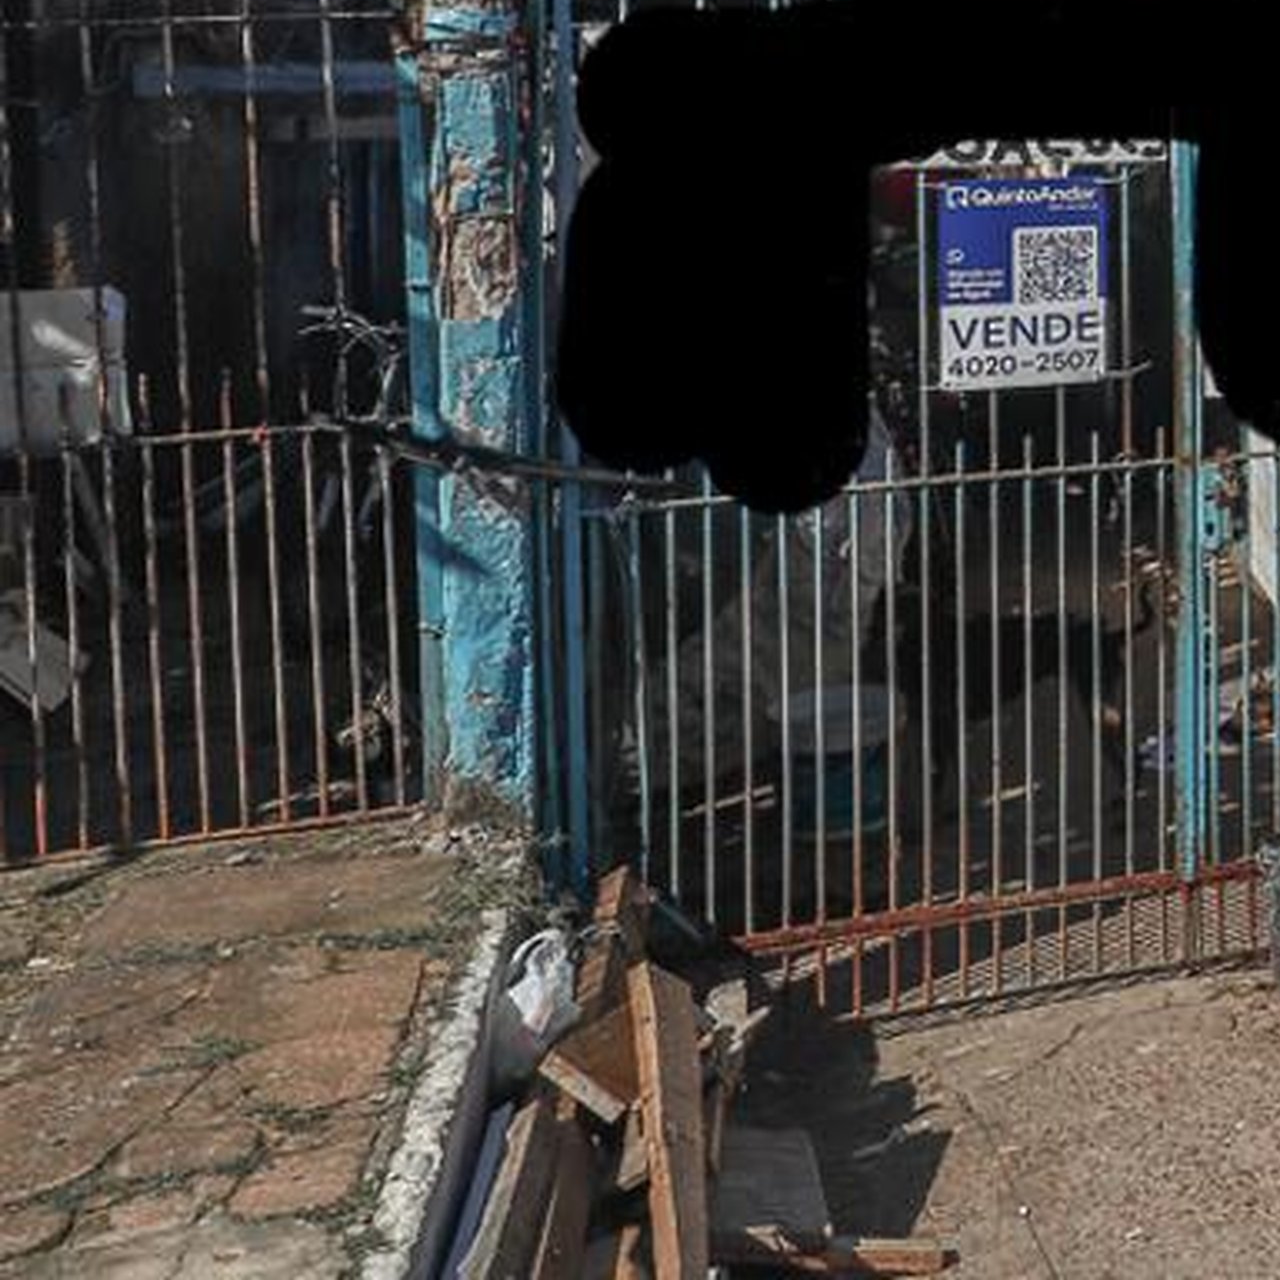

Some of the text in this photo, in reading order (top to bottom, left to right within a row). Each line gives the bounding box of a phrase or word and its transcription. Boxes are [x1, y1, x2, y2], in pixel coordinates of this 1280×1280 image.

[970, 185, 1096, 206] QuintoAndar
[948, 310, 1101, 350] VENDE
[947, 348, 1100, 378] 4020-2507
